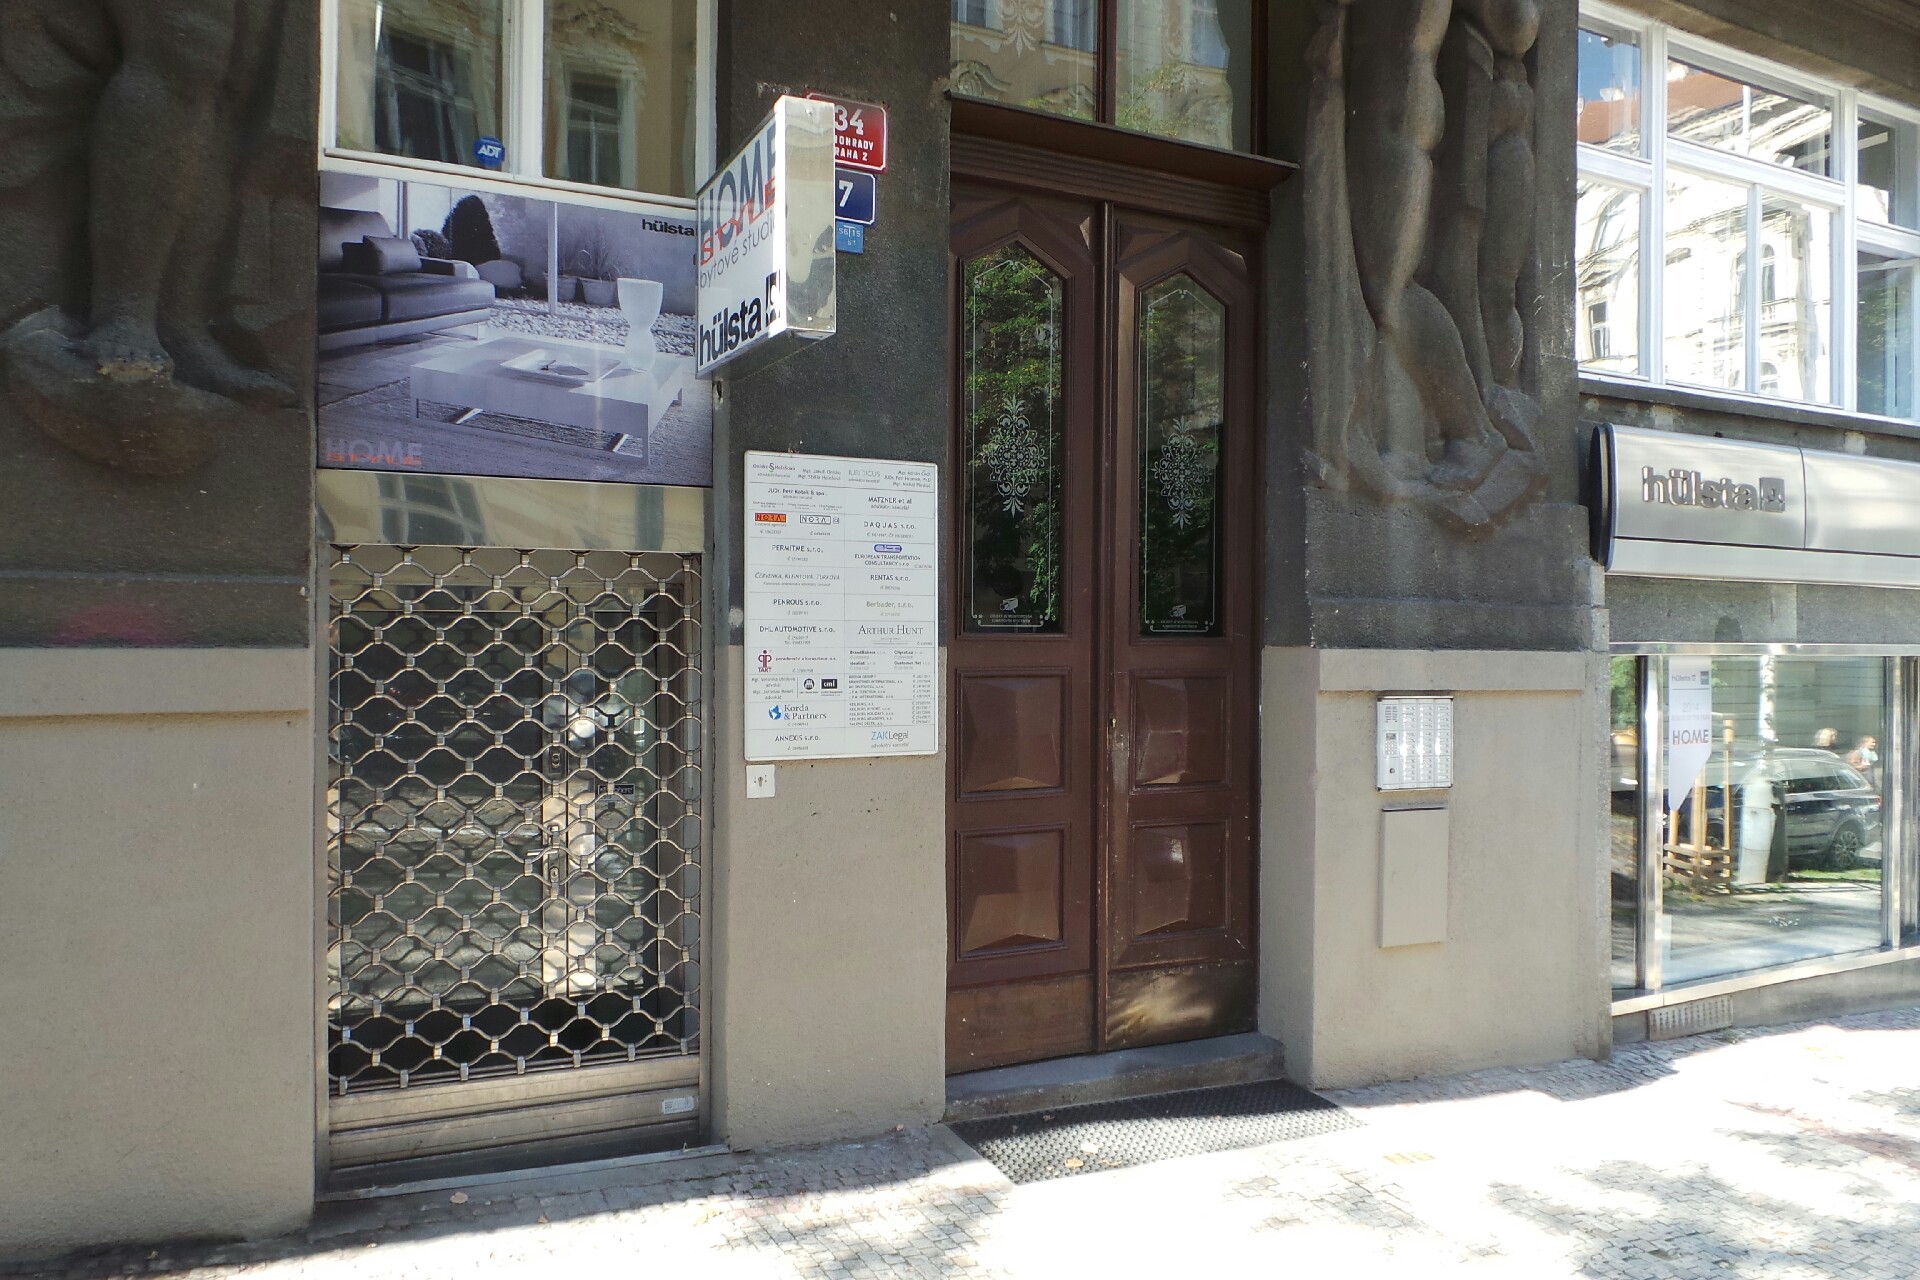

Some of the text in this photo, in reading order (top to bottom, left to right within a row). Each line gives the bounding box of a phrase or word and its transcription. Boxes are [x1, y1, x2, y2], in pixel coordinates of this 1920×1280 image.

[478, 144, 502, 158] ADT
[835, 135, 874, 151] OHRADY
[835, 147, 869, 162] RAHA 2
[642, 219, 695, 236] hülsta
[701, 176, 776, 266] STYLE
[700, 208, 775, 289] bytové studi
[700, 297, 762, 367] hülsta
[326, 438, 423, 465] HOME
[1641, 466, 1759, 511] hülsta
[823, 680, 835, 688] cml
[784, 704, 809, 712] Korda
[1672, 730, 1709, 745] HOME
